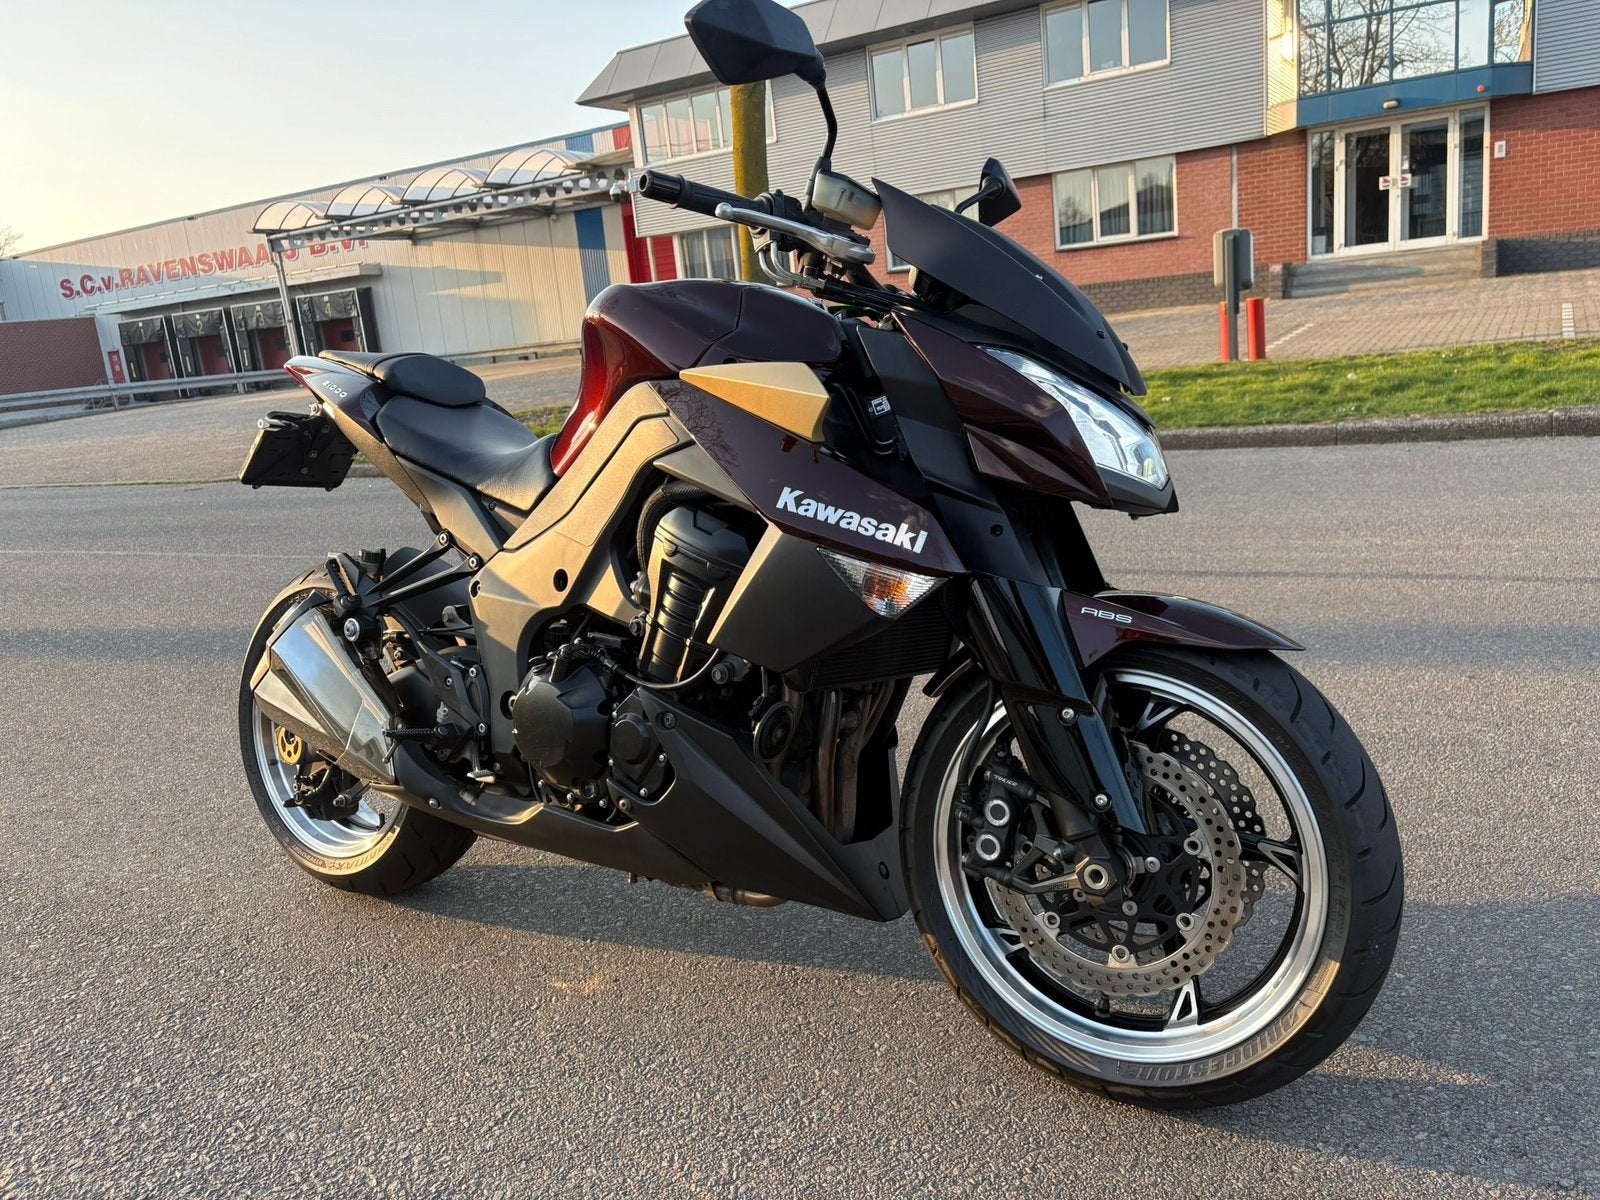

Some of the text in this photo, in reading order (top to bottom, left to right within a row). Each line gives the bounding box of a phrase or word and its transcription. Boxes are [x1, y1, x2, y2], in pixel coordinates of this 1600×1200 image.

[256, 311, 265, 326] 3
[324, 302, 332, 318] 4
[196, 320, 204, 334] 2
[776, 486, 928, 554] Kawasaki
[1081, 606, 1133, 624] ABS
[1120, 1008, 1300, 1082] BRIDGESTONE
